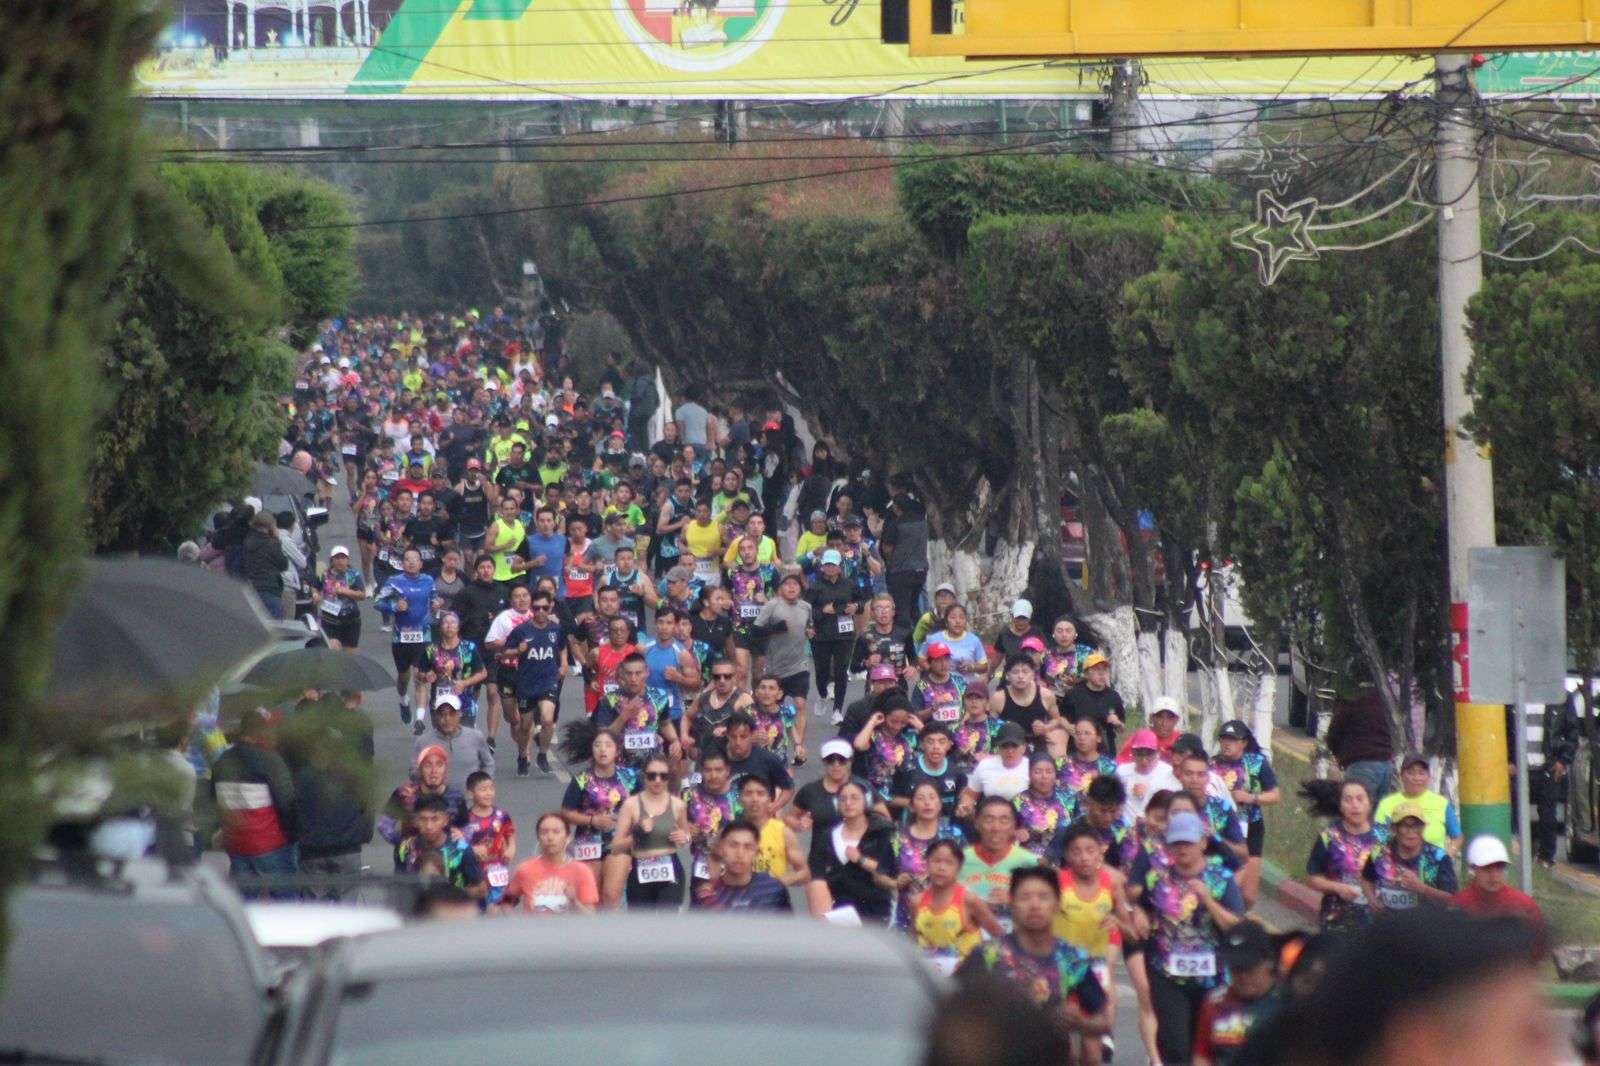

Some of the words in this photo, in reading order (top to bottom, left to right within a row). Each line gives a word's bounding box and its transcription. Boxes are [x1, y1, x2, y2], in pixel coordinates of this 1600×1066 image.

[528, 646, 554, 660] AIA
[936, 710, 956, 719] 198
[628, 736, 651, 747] 534
[641, 866, 669, 880] 608
[1176, 959, 1210, 972] 624
